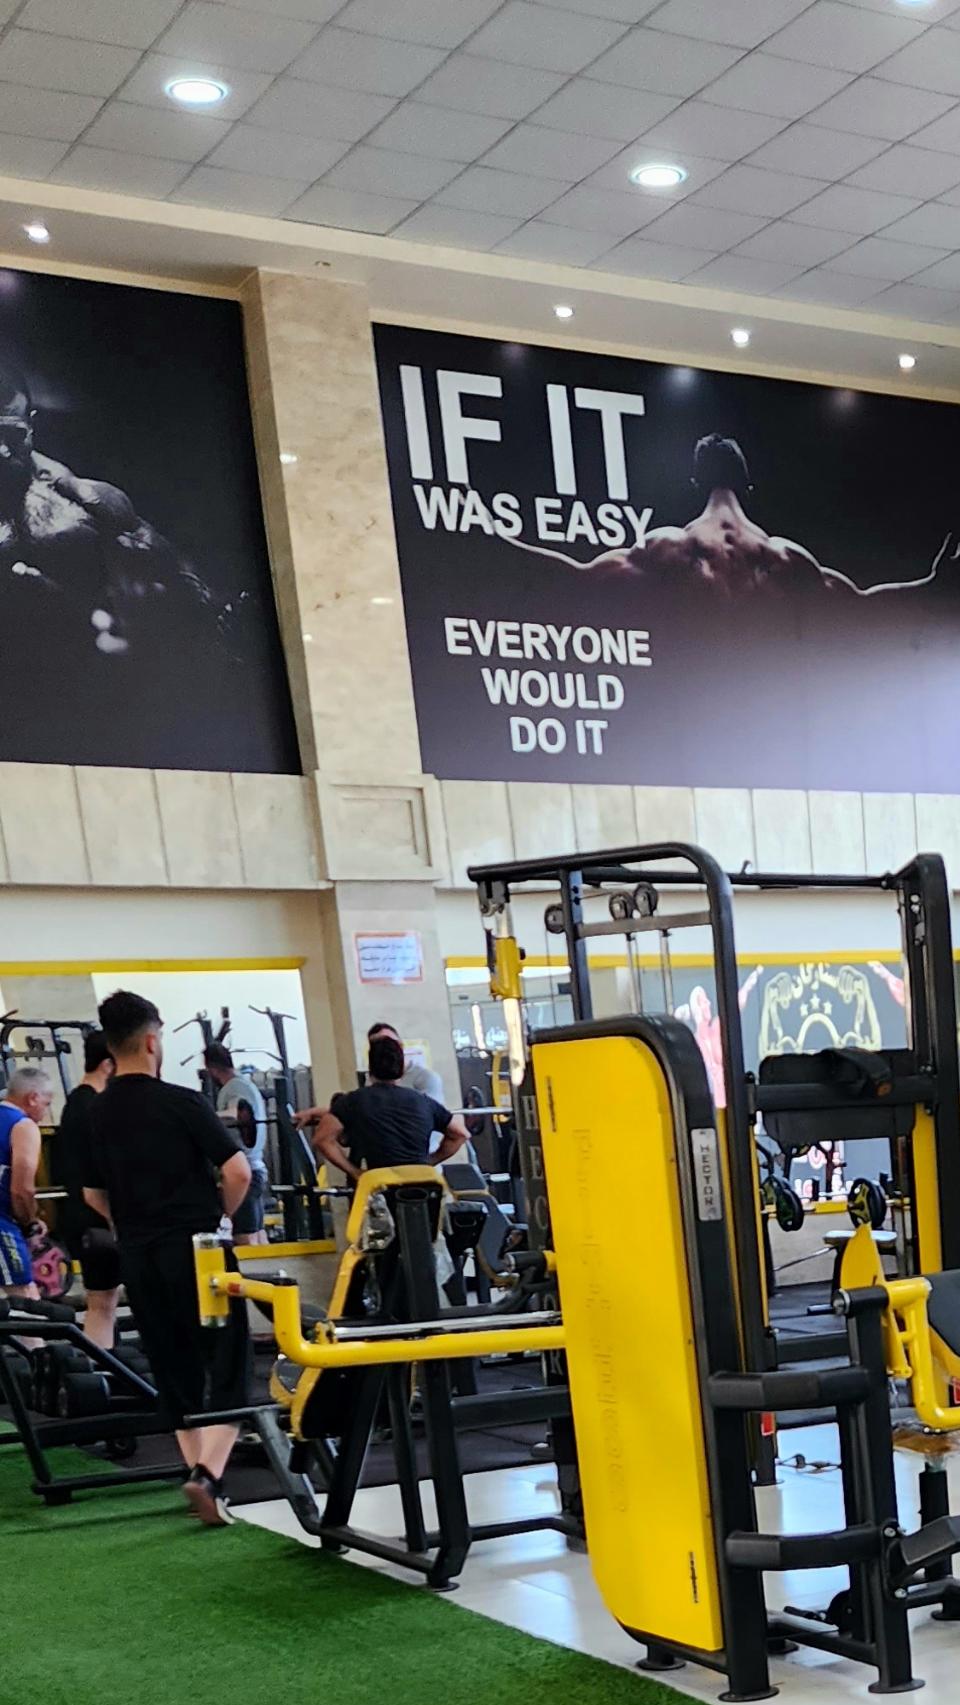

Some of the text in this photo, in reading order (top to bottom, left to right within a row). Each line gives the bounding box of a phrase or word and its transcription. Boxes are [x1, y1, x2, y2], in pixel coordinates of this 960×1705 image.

[400, 365, 645, 501] IF IT
[412, 484, 654, 549] WAS EASY
[444, 617, 653, 667] EVERYONE
[481, 667, 625, 710] WOULD
[509, 716, 609, 755] DO IT
